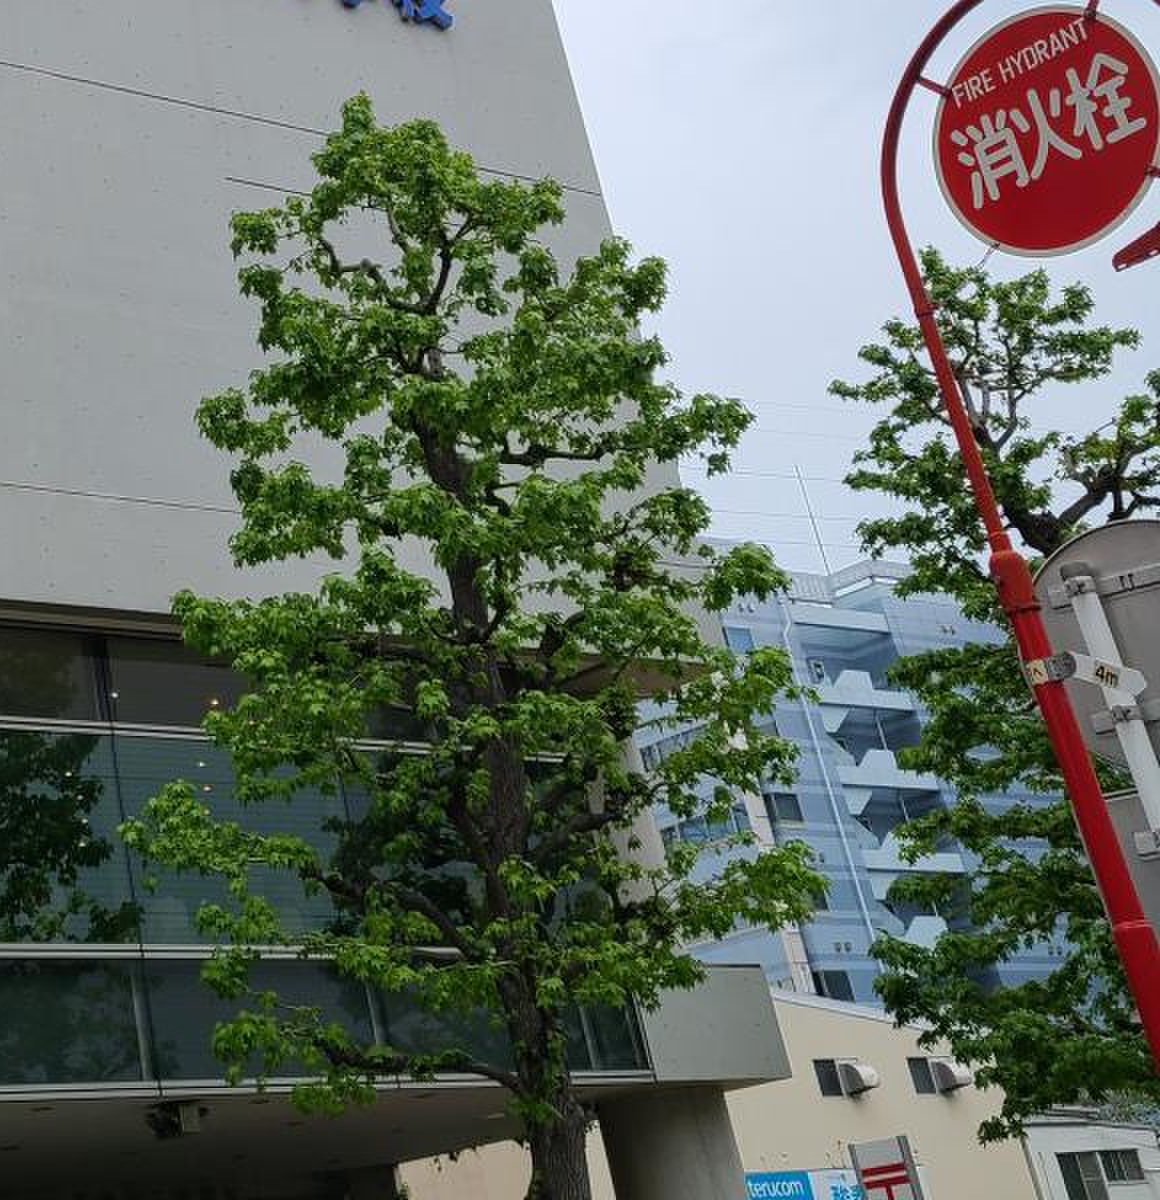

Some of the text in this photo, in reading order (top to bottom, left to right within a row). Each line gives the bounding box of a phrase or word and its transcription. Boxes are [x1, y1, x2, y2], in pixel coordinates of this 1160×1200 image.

[951, 19, 1089, 109] FIRE HYDRANT
[950, 52, 1146, 209] 消火栓
[747, 1180, 804, 1198] terucom
